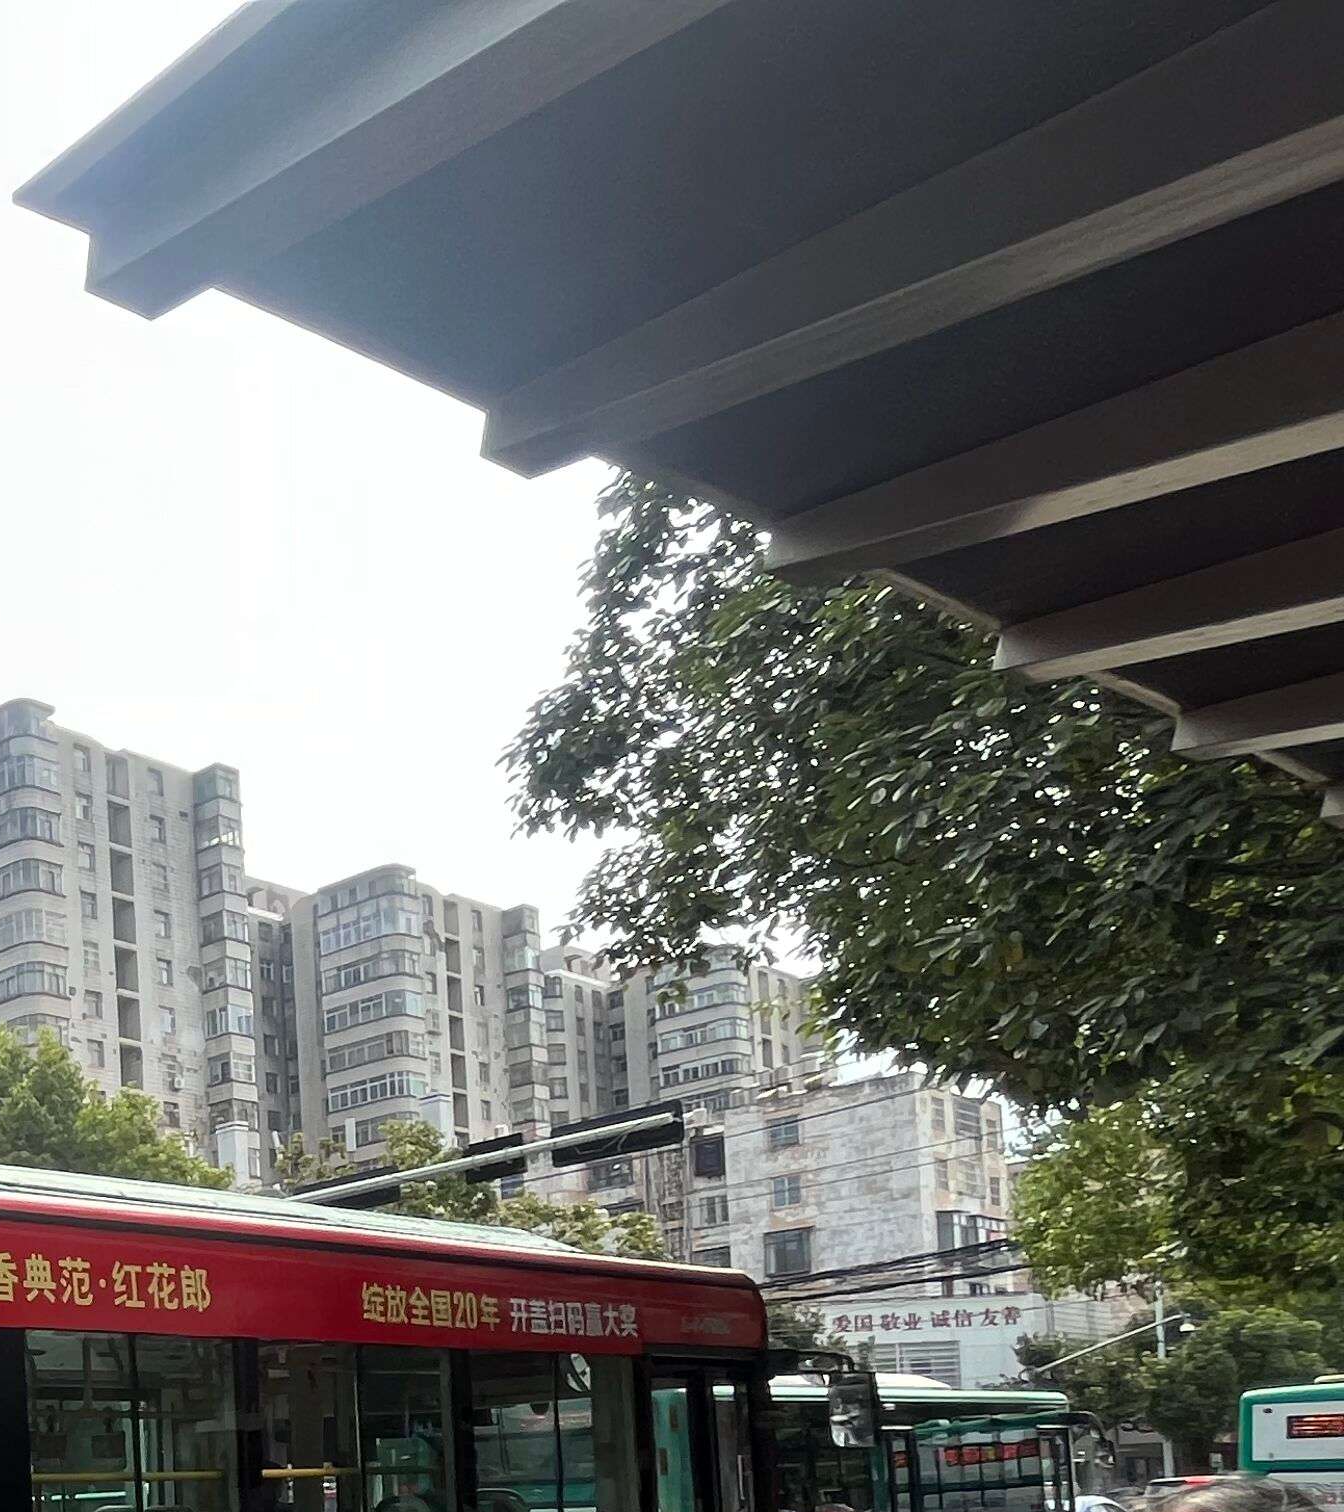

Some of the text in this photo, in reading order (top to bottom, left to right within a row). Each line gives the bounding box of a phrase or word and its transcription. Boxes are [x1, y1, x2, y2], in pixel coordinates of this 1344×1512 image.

[360, 1280, 501, 1332] 绽放全国20年
[509, 1297, 640, 1338] 开盖扫码赢大奖
[832, 1313, 873, 1334] 爱国
[880, 1311, 923, 1331] 敬业
[930, 1308, 973, 1328] 诚信
